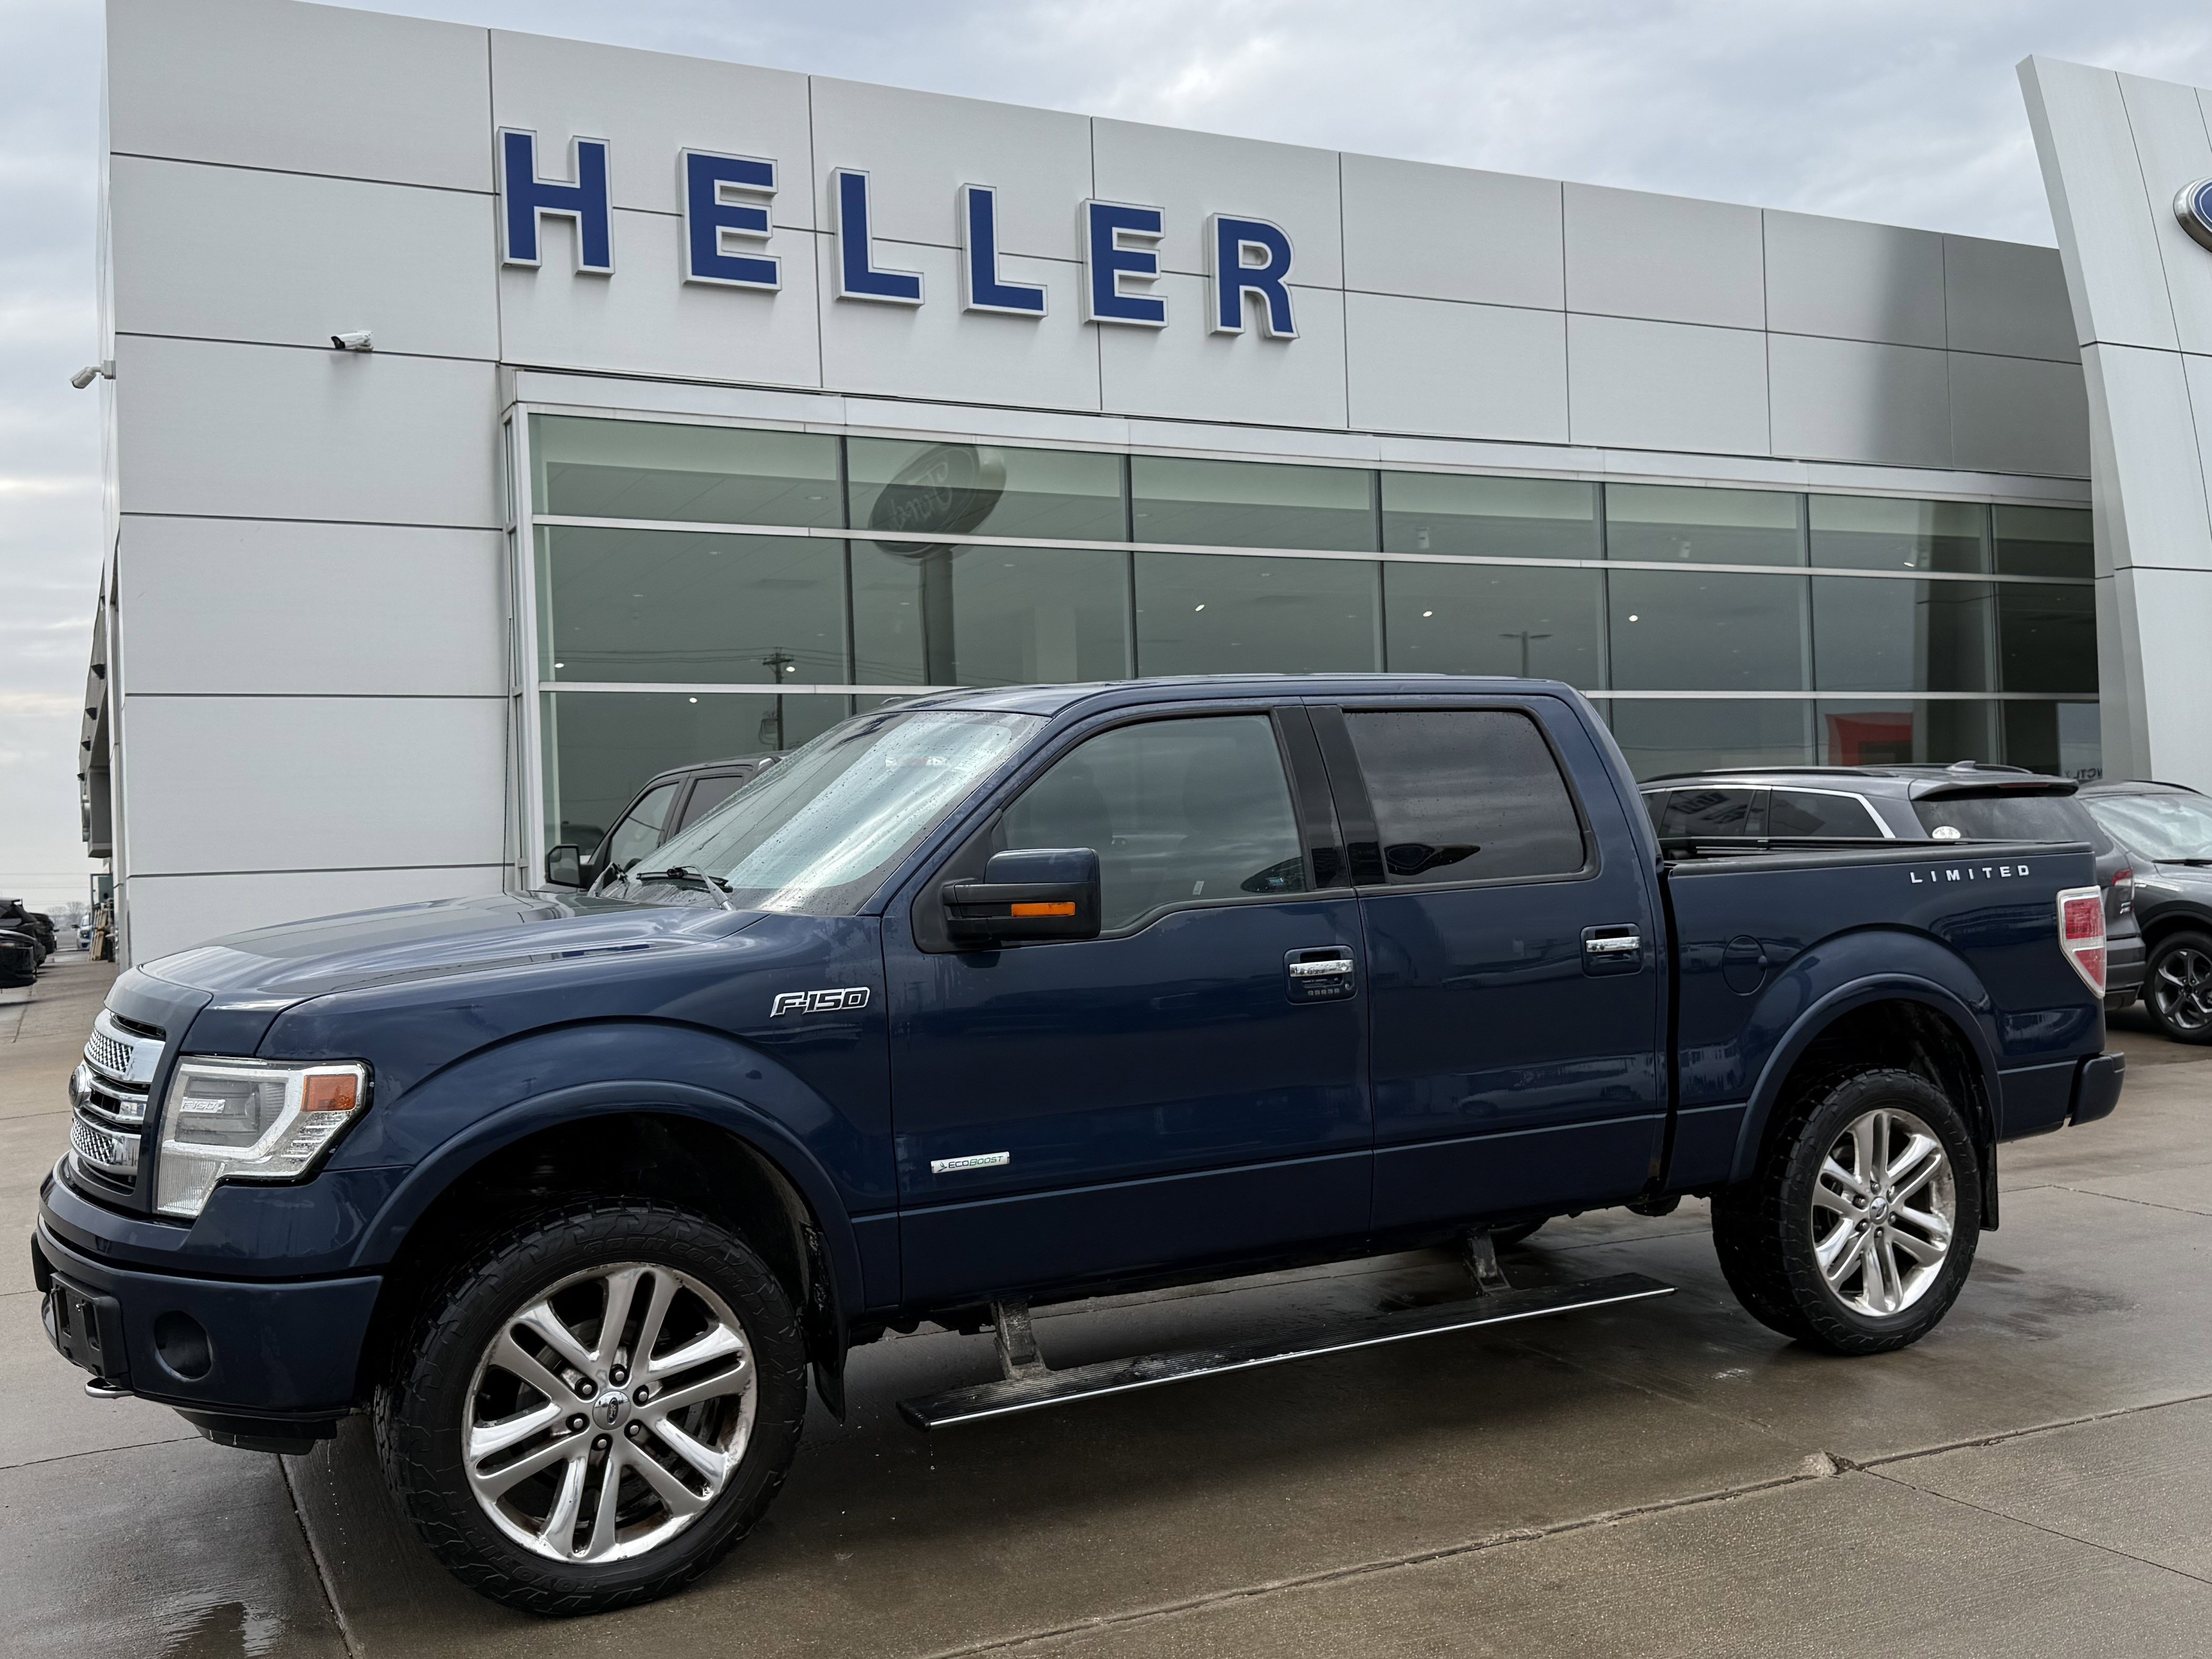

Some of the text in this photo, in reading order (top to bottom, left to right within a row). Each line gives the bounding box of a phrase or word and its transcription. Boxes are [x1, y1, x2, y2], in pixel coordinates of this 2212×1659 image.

[499, 126, 1300, 339] HELLER
[1910, 865, 2029, 884] LIMITED
[769, 987, 871, 1018] F-150
[583, 1236, 667, 1255] OPEN
[511, 1563, 596, 1592] TOYO
